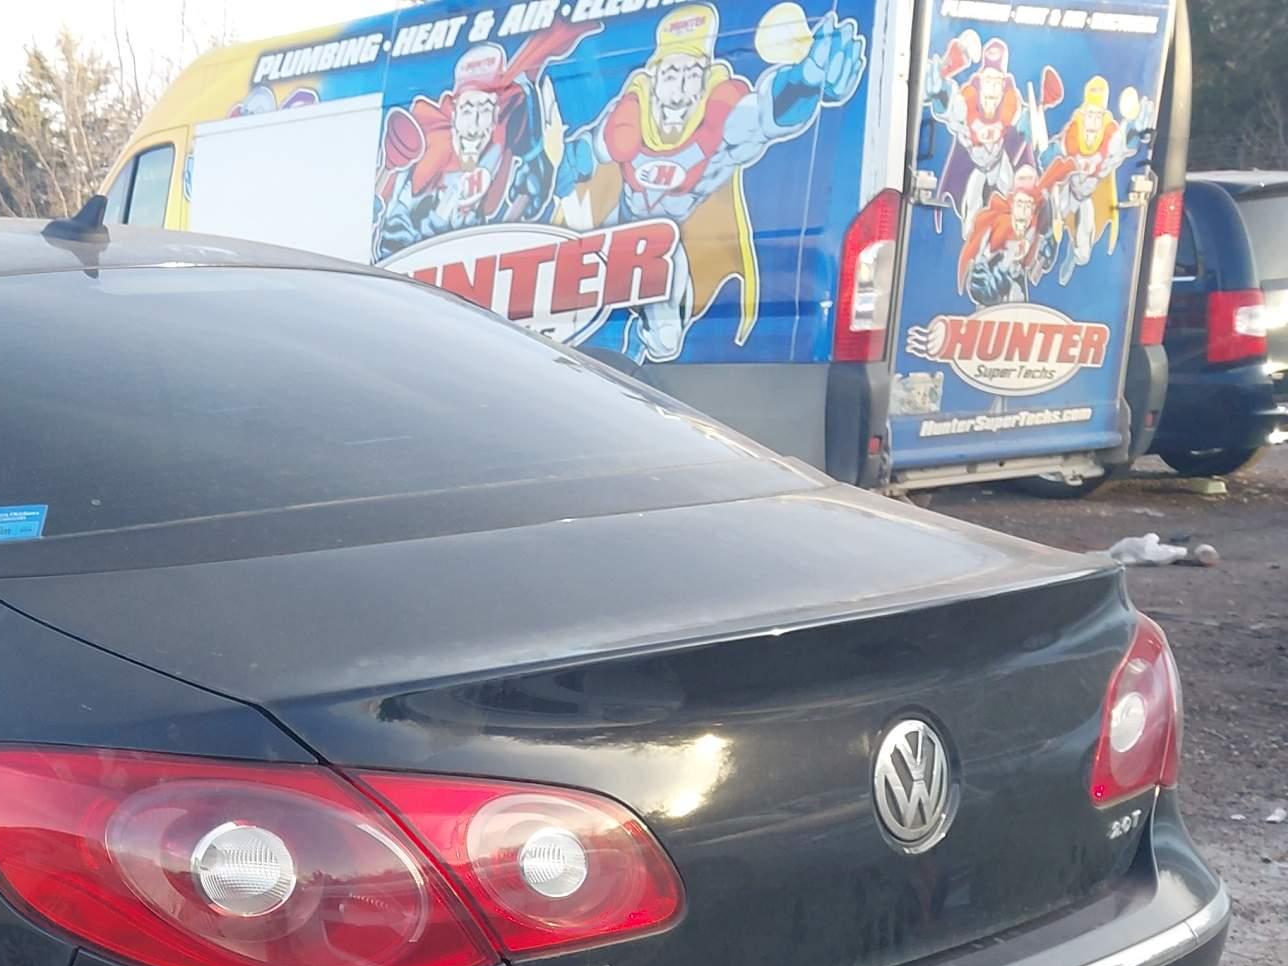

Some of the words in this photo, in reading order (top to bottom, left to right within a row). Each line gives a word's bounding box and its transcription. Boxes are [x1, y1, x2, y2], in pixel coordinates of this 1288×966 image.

[253, 33, 383, 83] PLUMBING
[392, 16, 467, 57] HEAT
[468, 10, 495, 42] &
[497, 0, 558, 37] AIR
[404, 222, 675, 321] NTER
[940, 319, 1108, 365] HUNTER
[920, 408, 1092, 437] HunterSuperTechs.com
